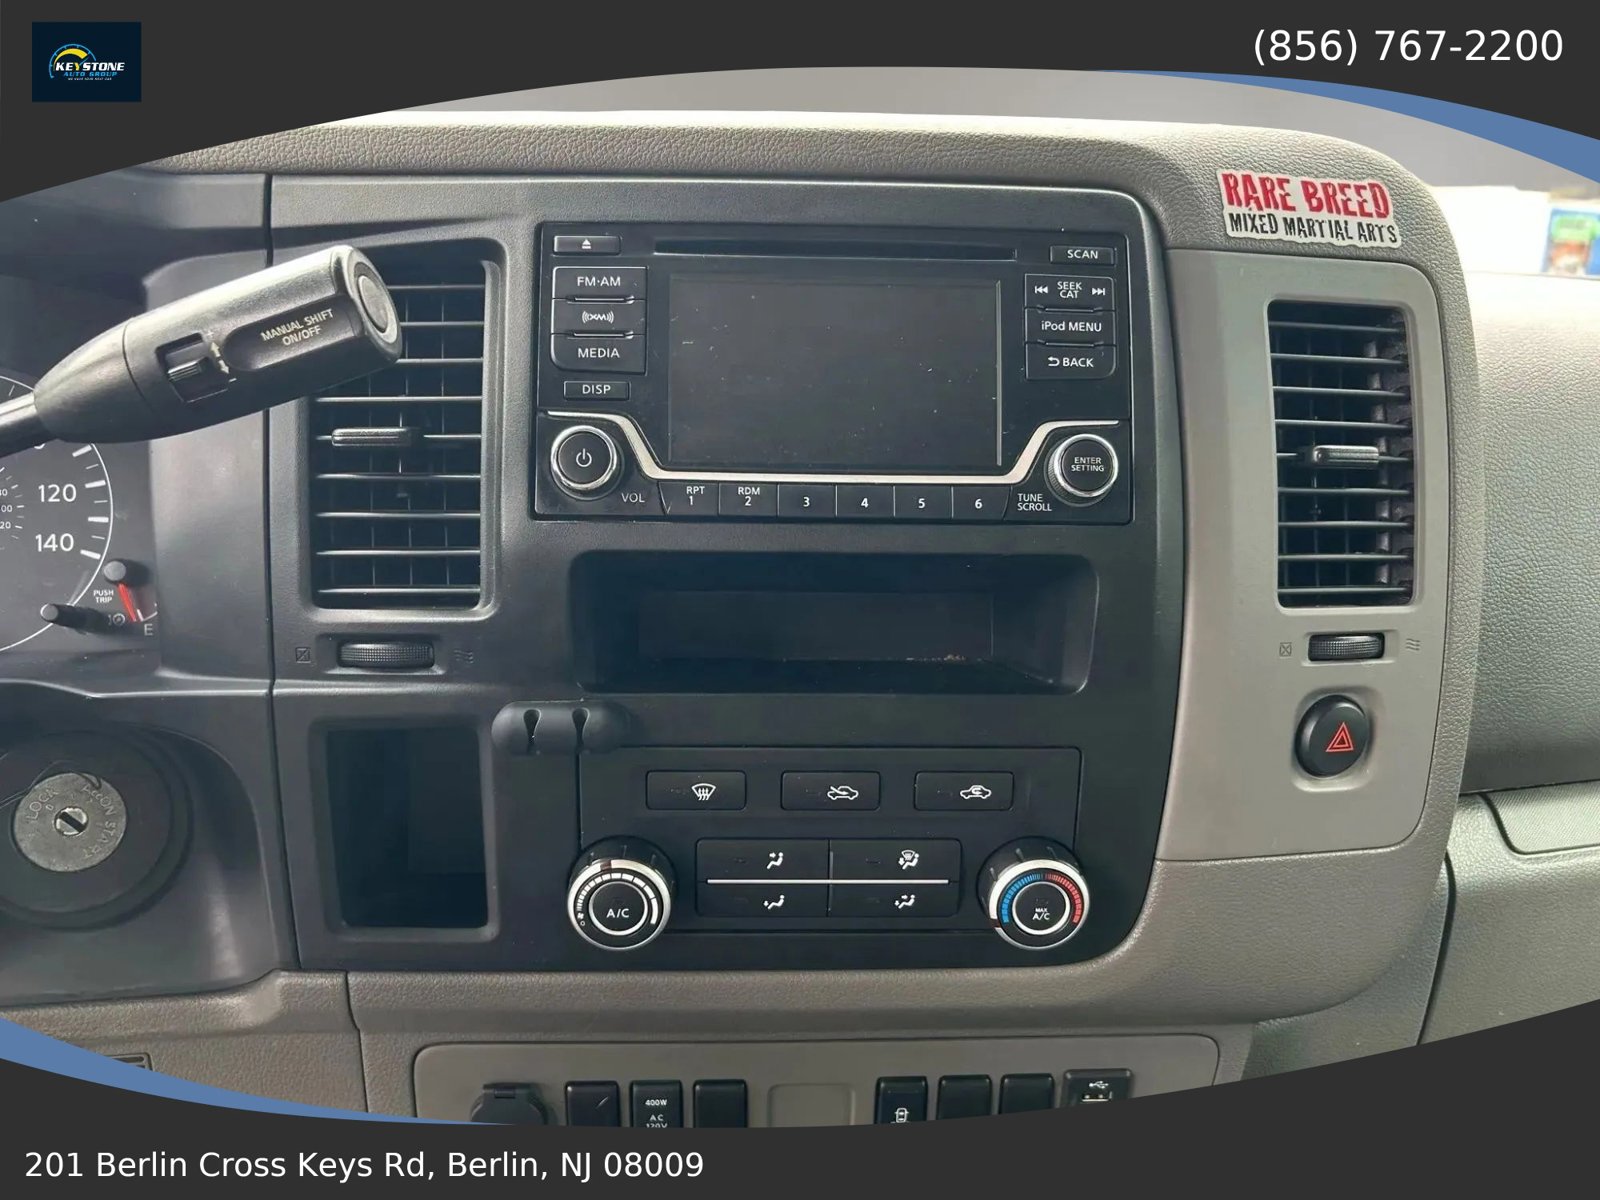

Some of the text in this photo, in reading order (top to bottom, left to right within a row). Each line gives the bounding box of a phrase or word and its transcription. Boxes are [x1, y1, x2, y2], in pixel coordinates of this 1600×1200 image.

[1222, 173, 1390, 219] RARE BREED
[1228, 212, 1398, 243] MIXED MARTIAL ARTS
[1067, 249, 1099, 260] SCAN
[1057, 281, 1083, 291] SEEK
[1059, 289, 1080, 299] CAT
[260, 308, 333, 341] MANUAL SHIFT
[1041, 320, 1102, 332] iPod MENU
[282, 325, 321, 346] ON/OFF
[577, 347, 621, 359] MEDIA
[1062, 357, 1094, 368] BACK
[582, 384, 612, 395] DISP
[1074, 456, 1102, 465] ENTER
[1070, 464, 1105, 473] SETTING
[38, 483, 77, 502] 120
[686, 485, 706, 495] RPT
[737, 486, 761, 496] RDM
[621, 492, 646, 504] VOL
[688, 495, 694, 506] 1
[744, 495, 752, 507] 2
[802, 496, 811, 508] 3
[860, 497, 870, 509] 4
[918, 498, 926, 509] 5
[974, 498, 983, 509] 6
[1017, 493, 1044, 503] TUNE
[1017, 502, 1053, 512] SCROLL
[35, 533, 74, 552] 140
[93, 589, 114, 597] PUSH
[95, 596, 113, 604] TRIP
[144, 623, 153, 636] E
[26, 788, 59, 819] LOCK
[83, 820, 117, 859] START
[606, 908, 630, 919] A/C
[1032, 912, 1050, 921] A/C
